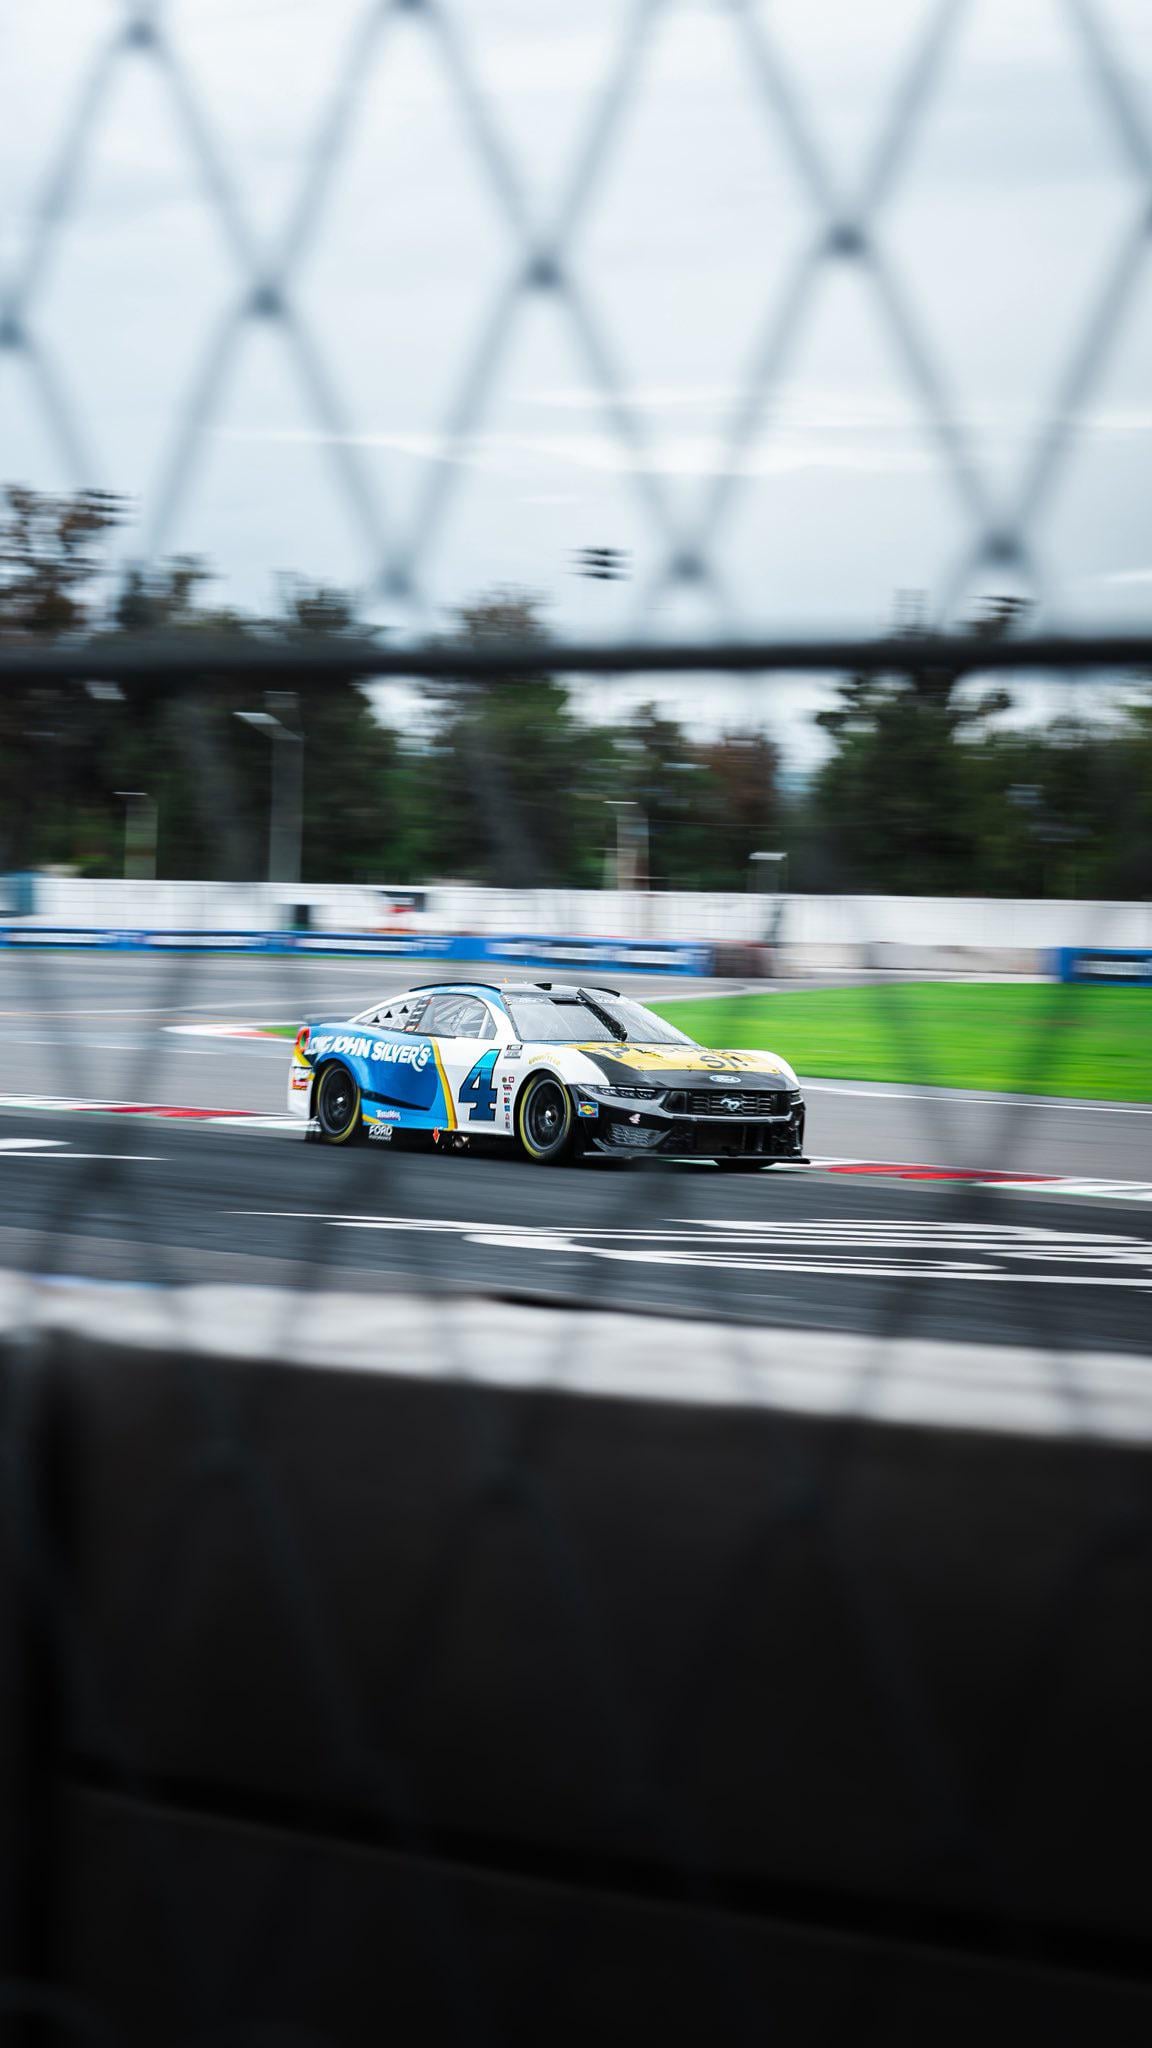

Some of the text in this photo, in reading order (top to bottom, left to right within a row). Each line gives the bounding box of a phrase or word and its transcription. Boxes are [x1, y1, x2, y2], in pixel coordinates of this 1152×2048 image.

[329, 1036, 373, 1058] JOHN
[371, 1041, 431, 1072] SILVER'S
[458, 1049, 502, 1121] 4
[369, 1124, 393, 1135] FORD
